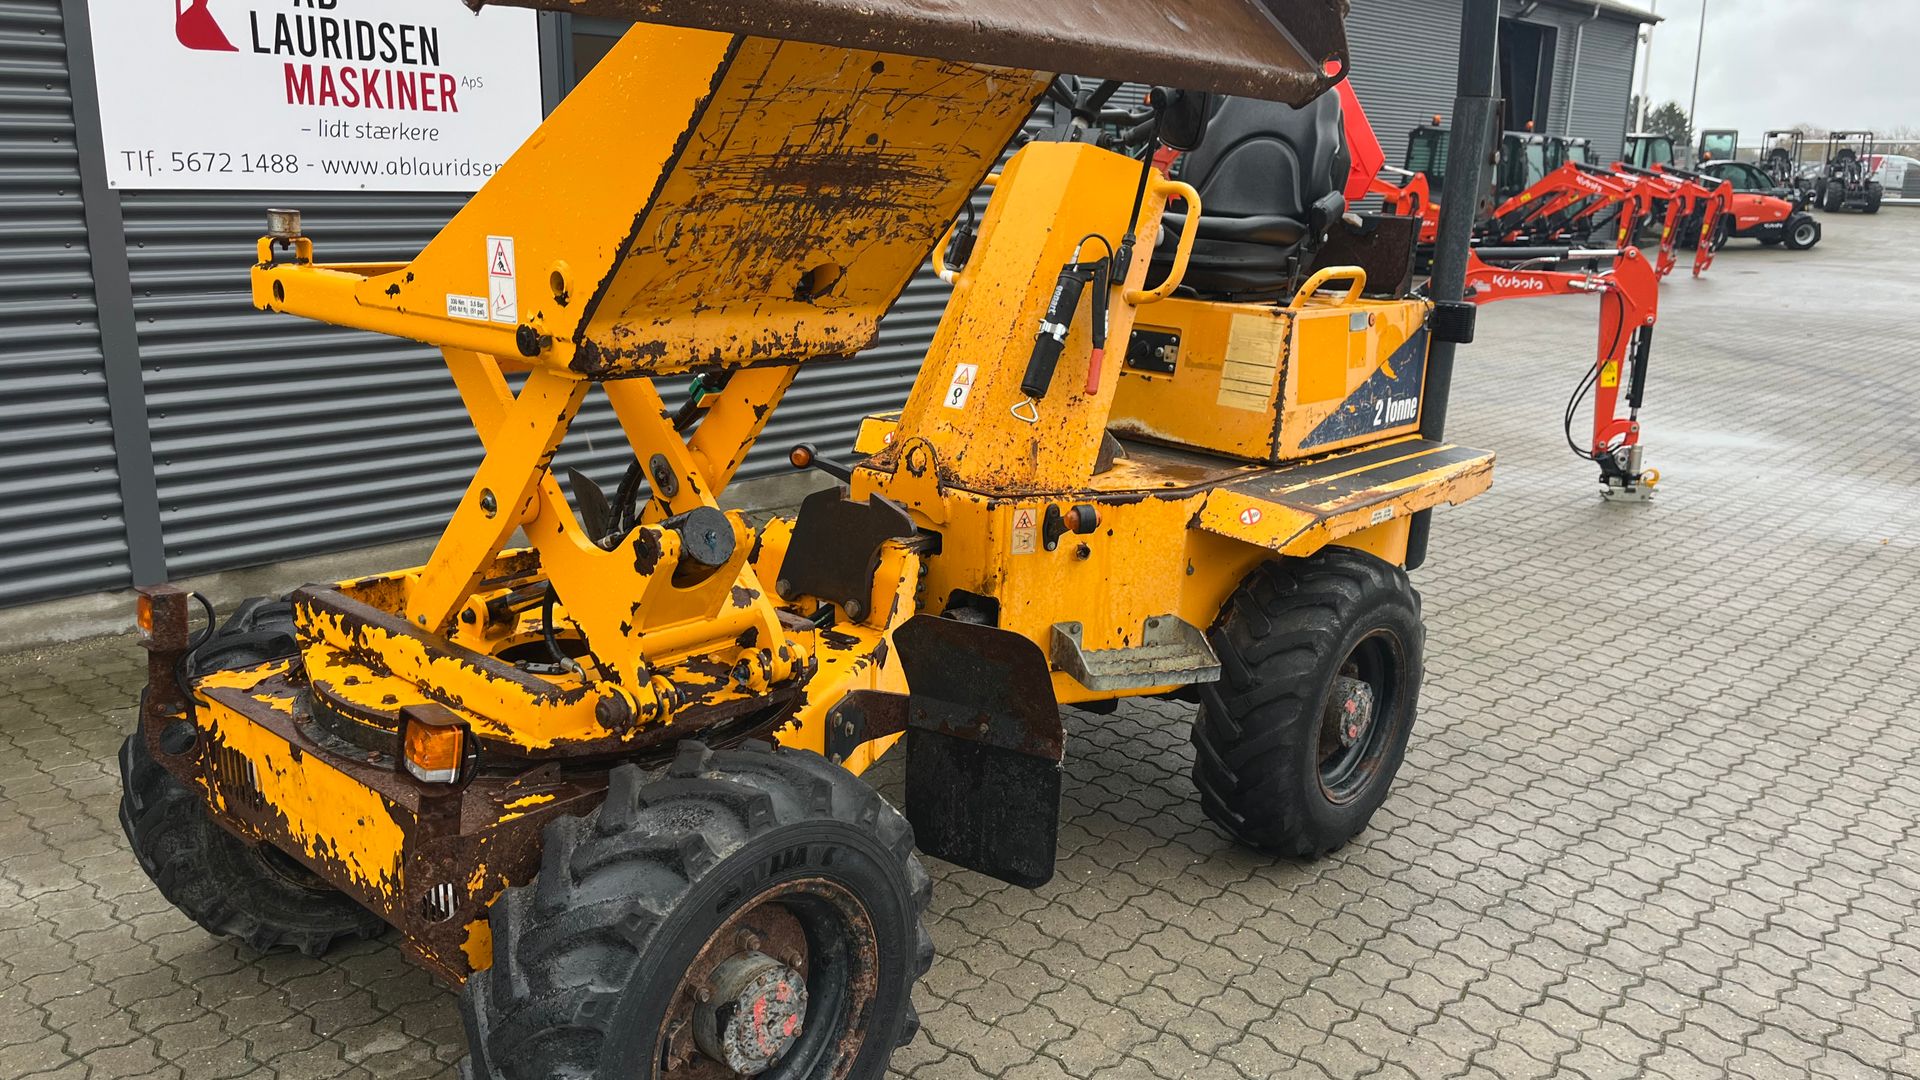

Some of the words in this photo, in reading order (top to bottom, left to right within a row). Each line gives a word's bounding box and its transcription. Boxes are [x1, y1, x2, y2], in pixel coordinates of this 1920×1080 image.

[249, 10, 440, 67] LAURIDSEN
[283, 62, 459, 113] MASKINER
[461, 75, 484, 91] ApS
[318, 118, 350, 139] lidt
[355, 121, 440, 142] stærkere
[120, 150, 163, 177] Tlf.
[171, 151, 233, 173] 5672
[241, 153, 299, 174] 1488
[1492, 274, 1544, 290] Kubota
[1372, 399, 1384, 426] 2
[1386, 396, 1418, 424] tonne
